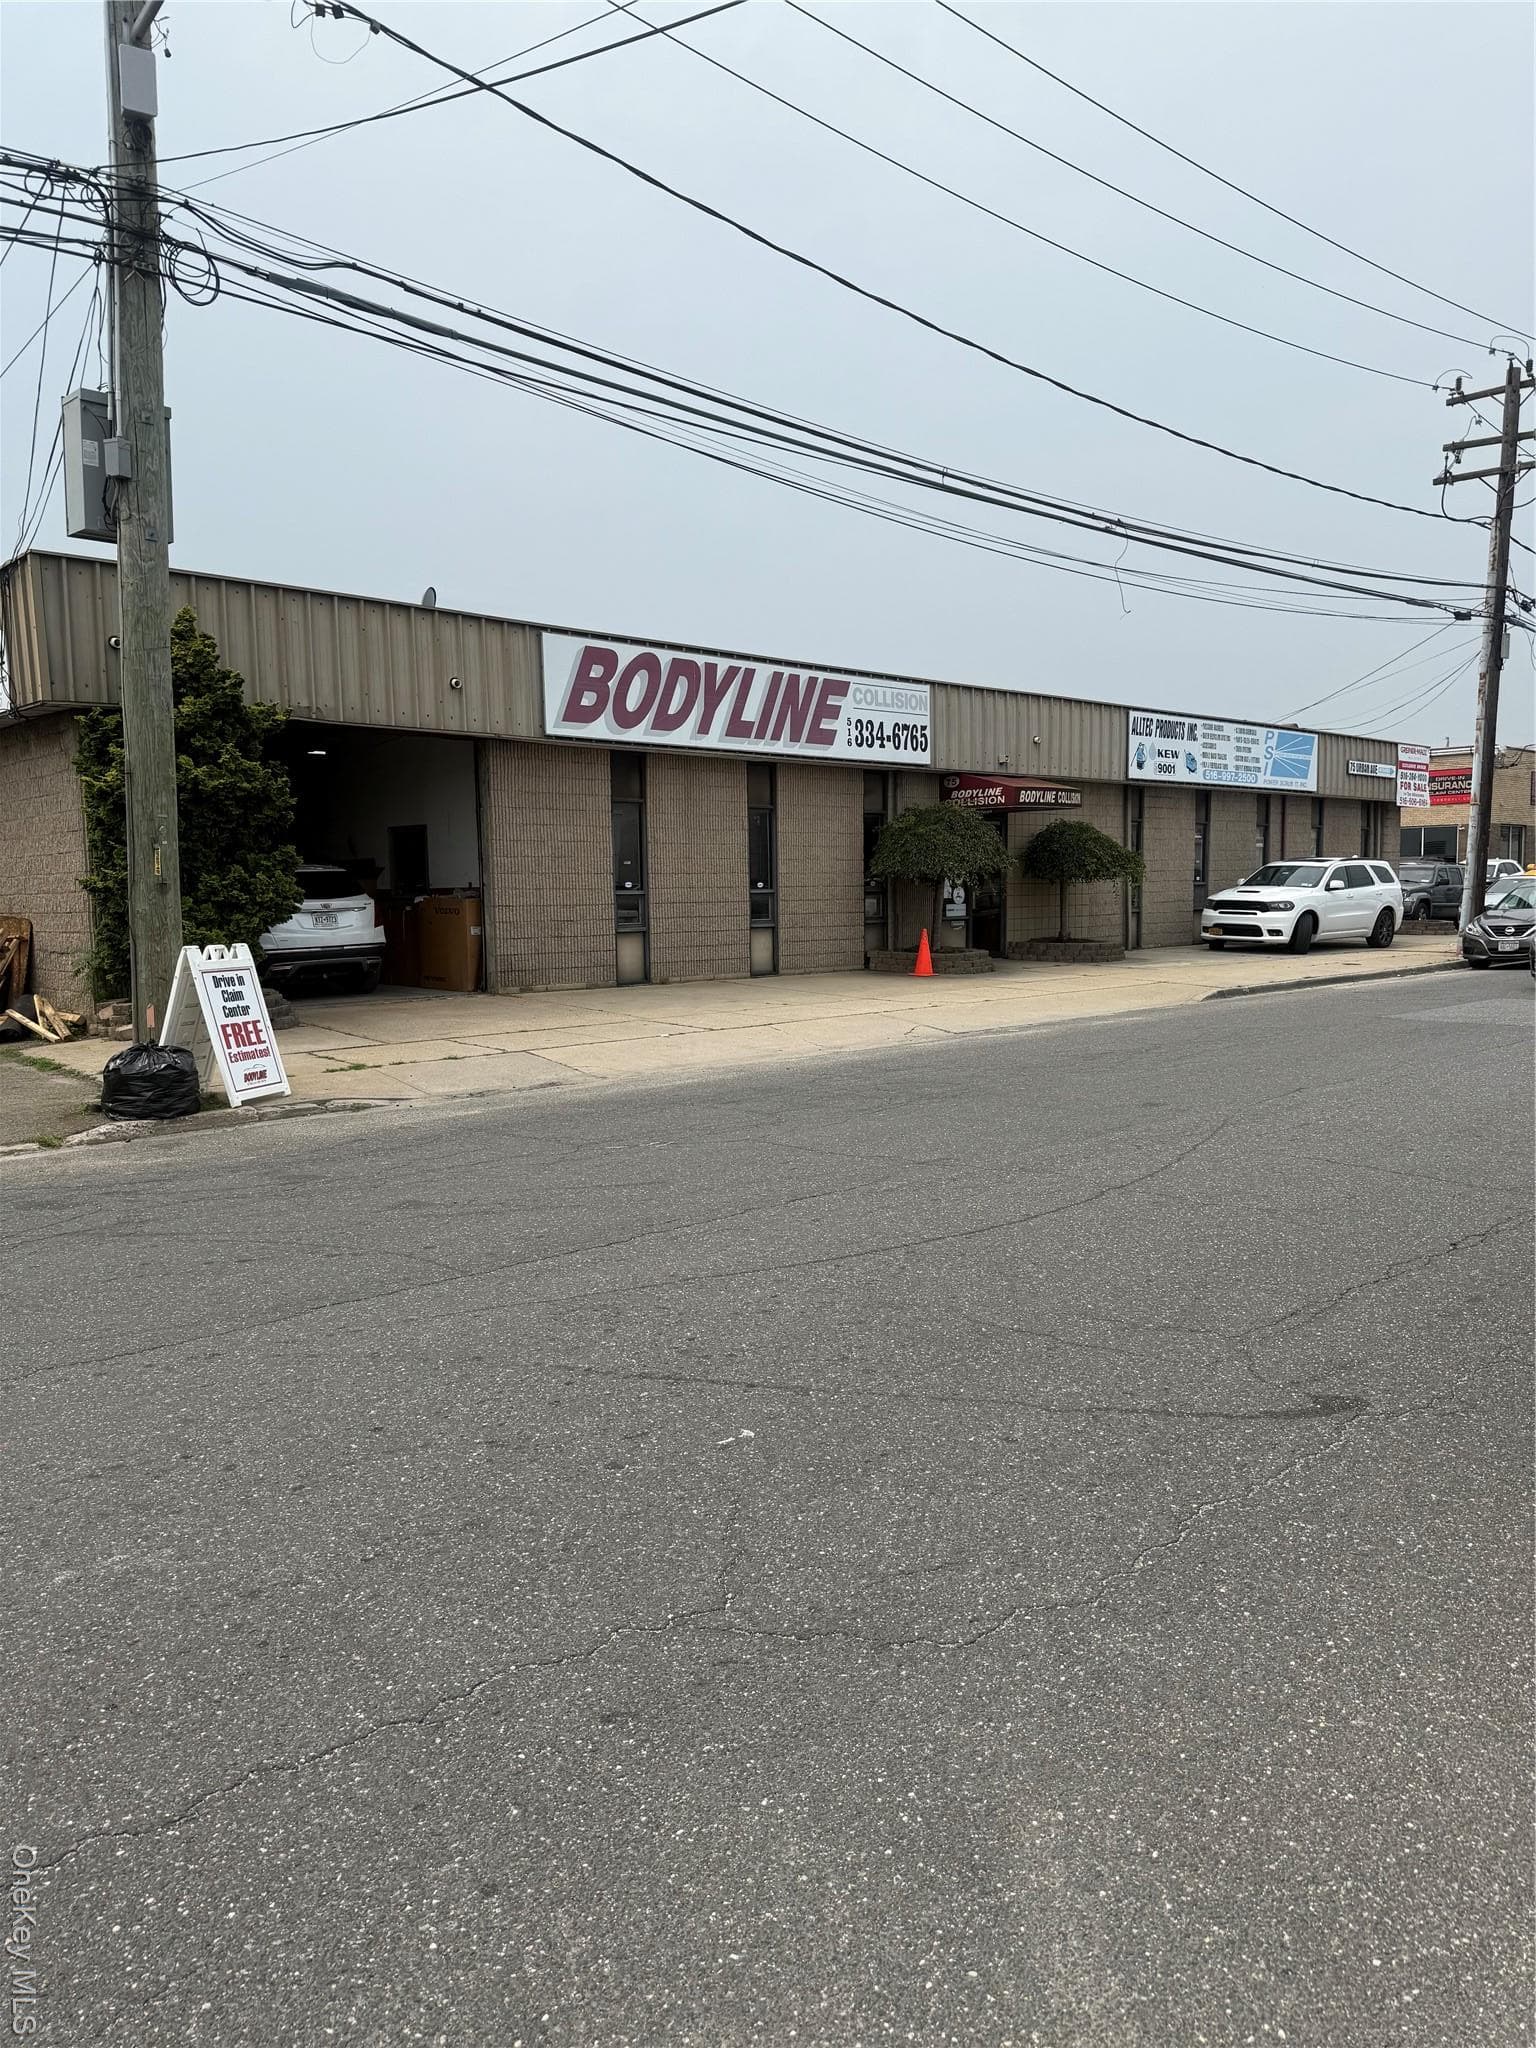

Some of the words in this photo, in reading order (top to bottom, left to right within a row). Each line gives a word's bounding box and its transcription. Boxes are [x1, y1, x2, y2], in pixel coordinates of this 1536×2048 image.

[558, 646, 850, 748] BODYLINE
[852, 687, 928, 711] COLLISION
[855, 718, 928, 752] 334-6765
[1131, 716, 1153, 737] ALLTEC
[1154, 718, 1185, 740] PRODUCTS
[1157, 748, 1180, 759] KEW
[1157, 763, 1176, 774] 9001
[1350, 762, 1355, 772] 75
[951, 787, 1003, 799] BODYLINE
[1400, 781, 1411, 791] FOR
[1413, 783, 1427, 792] SALE
[1019, 790, 1056, 803] BODYLINE
[1057, 791, 1081, 804] COLLISION
[211, 974, 236, 988] Drive
[236, 973, 246, 986] in
[221, 989, 245, 1003] Claim
[222, 1004, 251, 1018] Center
[220, 1019, 266, 1050] FREE
[228, 1046, 271, 1064] Estimates!
